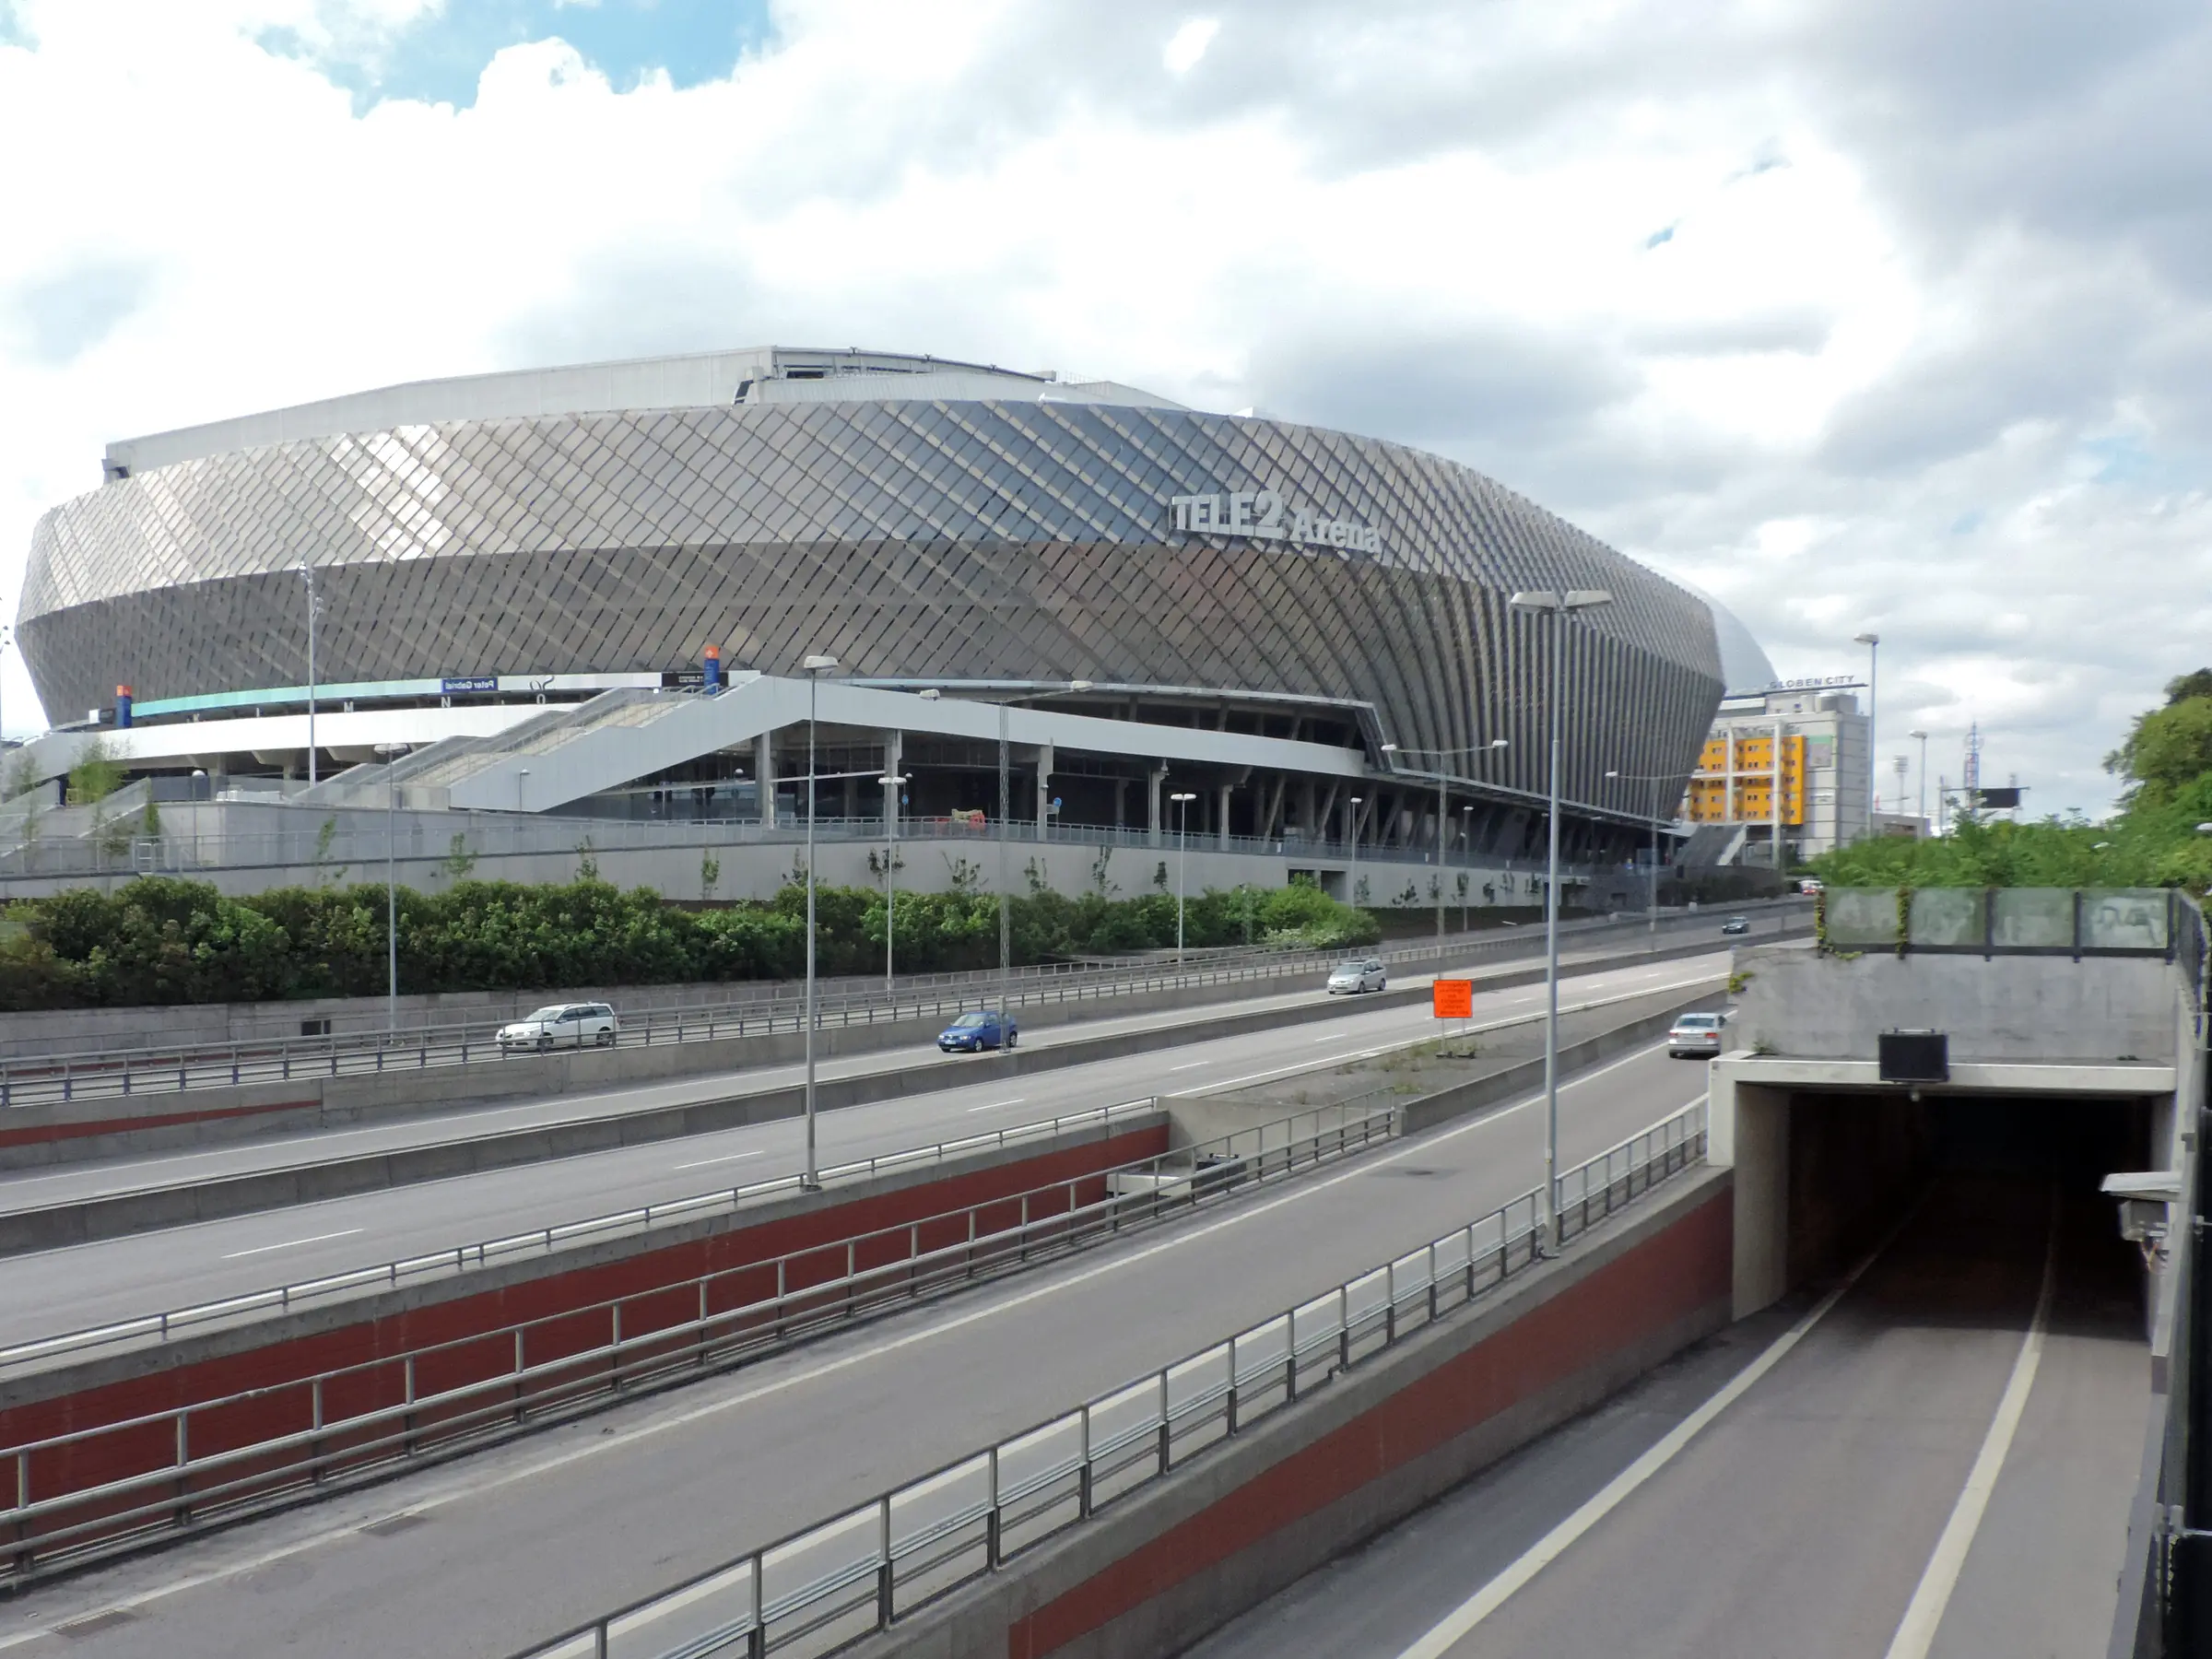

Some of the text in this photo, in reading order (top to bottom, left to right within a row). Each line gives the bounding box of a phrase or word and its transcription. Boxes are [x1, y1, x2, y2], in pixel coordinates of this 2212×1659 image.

[1171, 489, 1382, 553] TELE2 Arena
[1770, 675, 1854, 688] GLOBEN CITY
[441, 696, 451, 708] N
